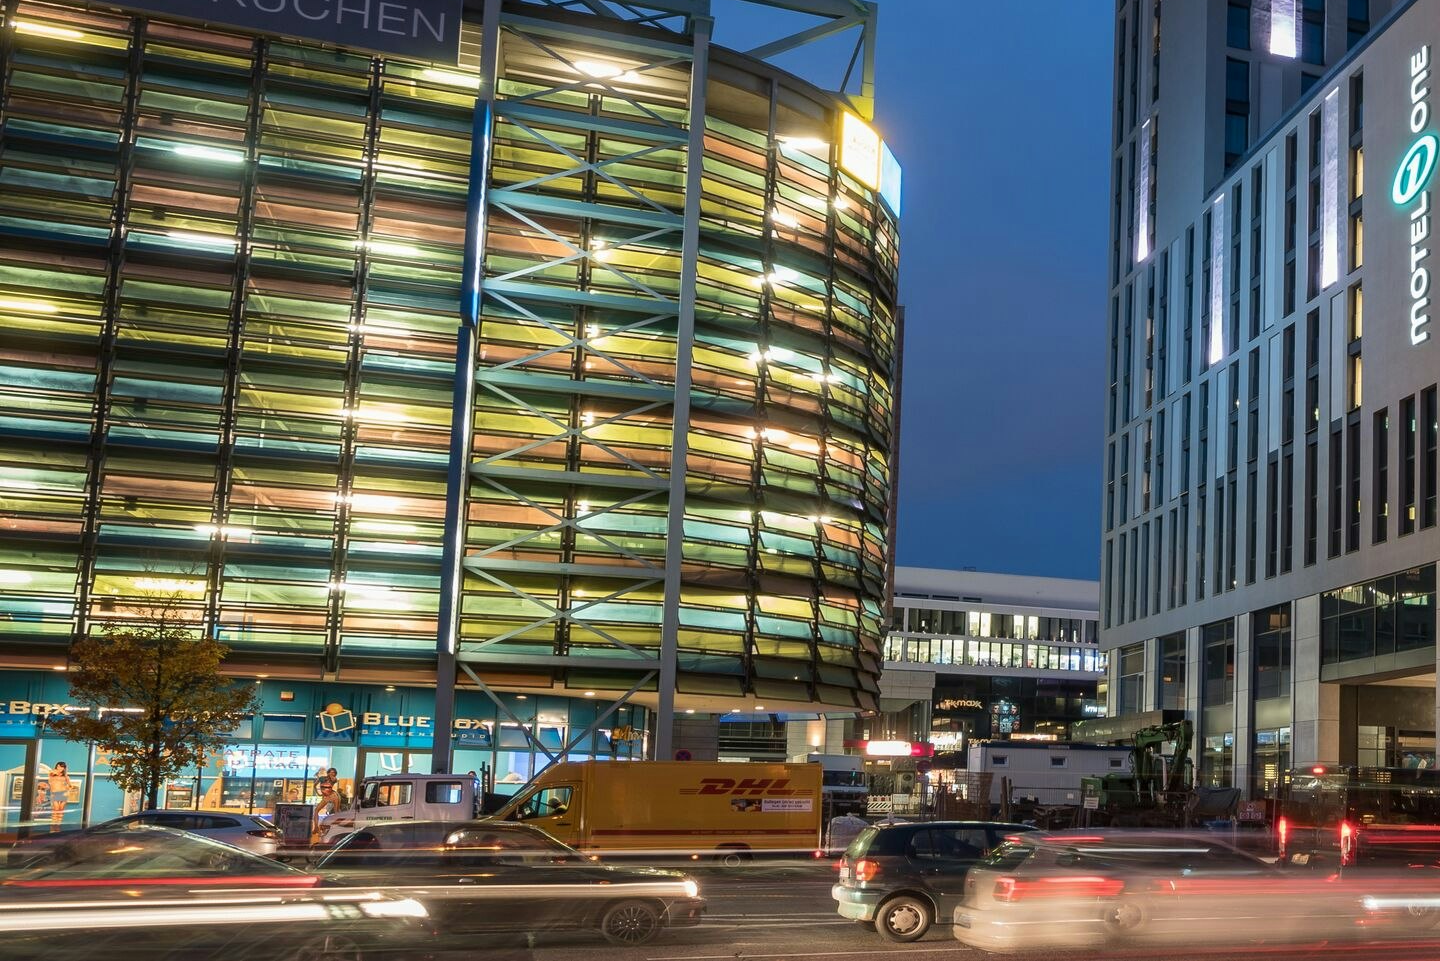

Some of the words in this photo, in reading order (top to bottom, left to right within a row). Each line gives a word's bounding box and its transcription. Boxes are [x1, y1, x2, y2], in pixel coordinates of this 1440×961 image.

[362, 712, 431, 727] BLUE
[451, 718, 488, 730] OX
[699, 778, 795, 796] DHL
